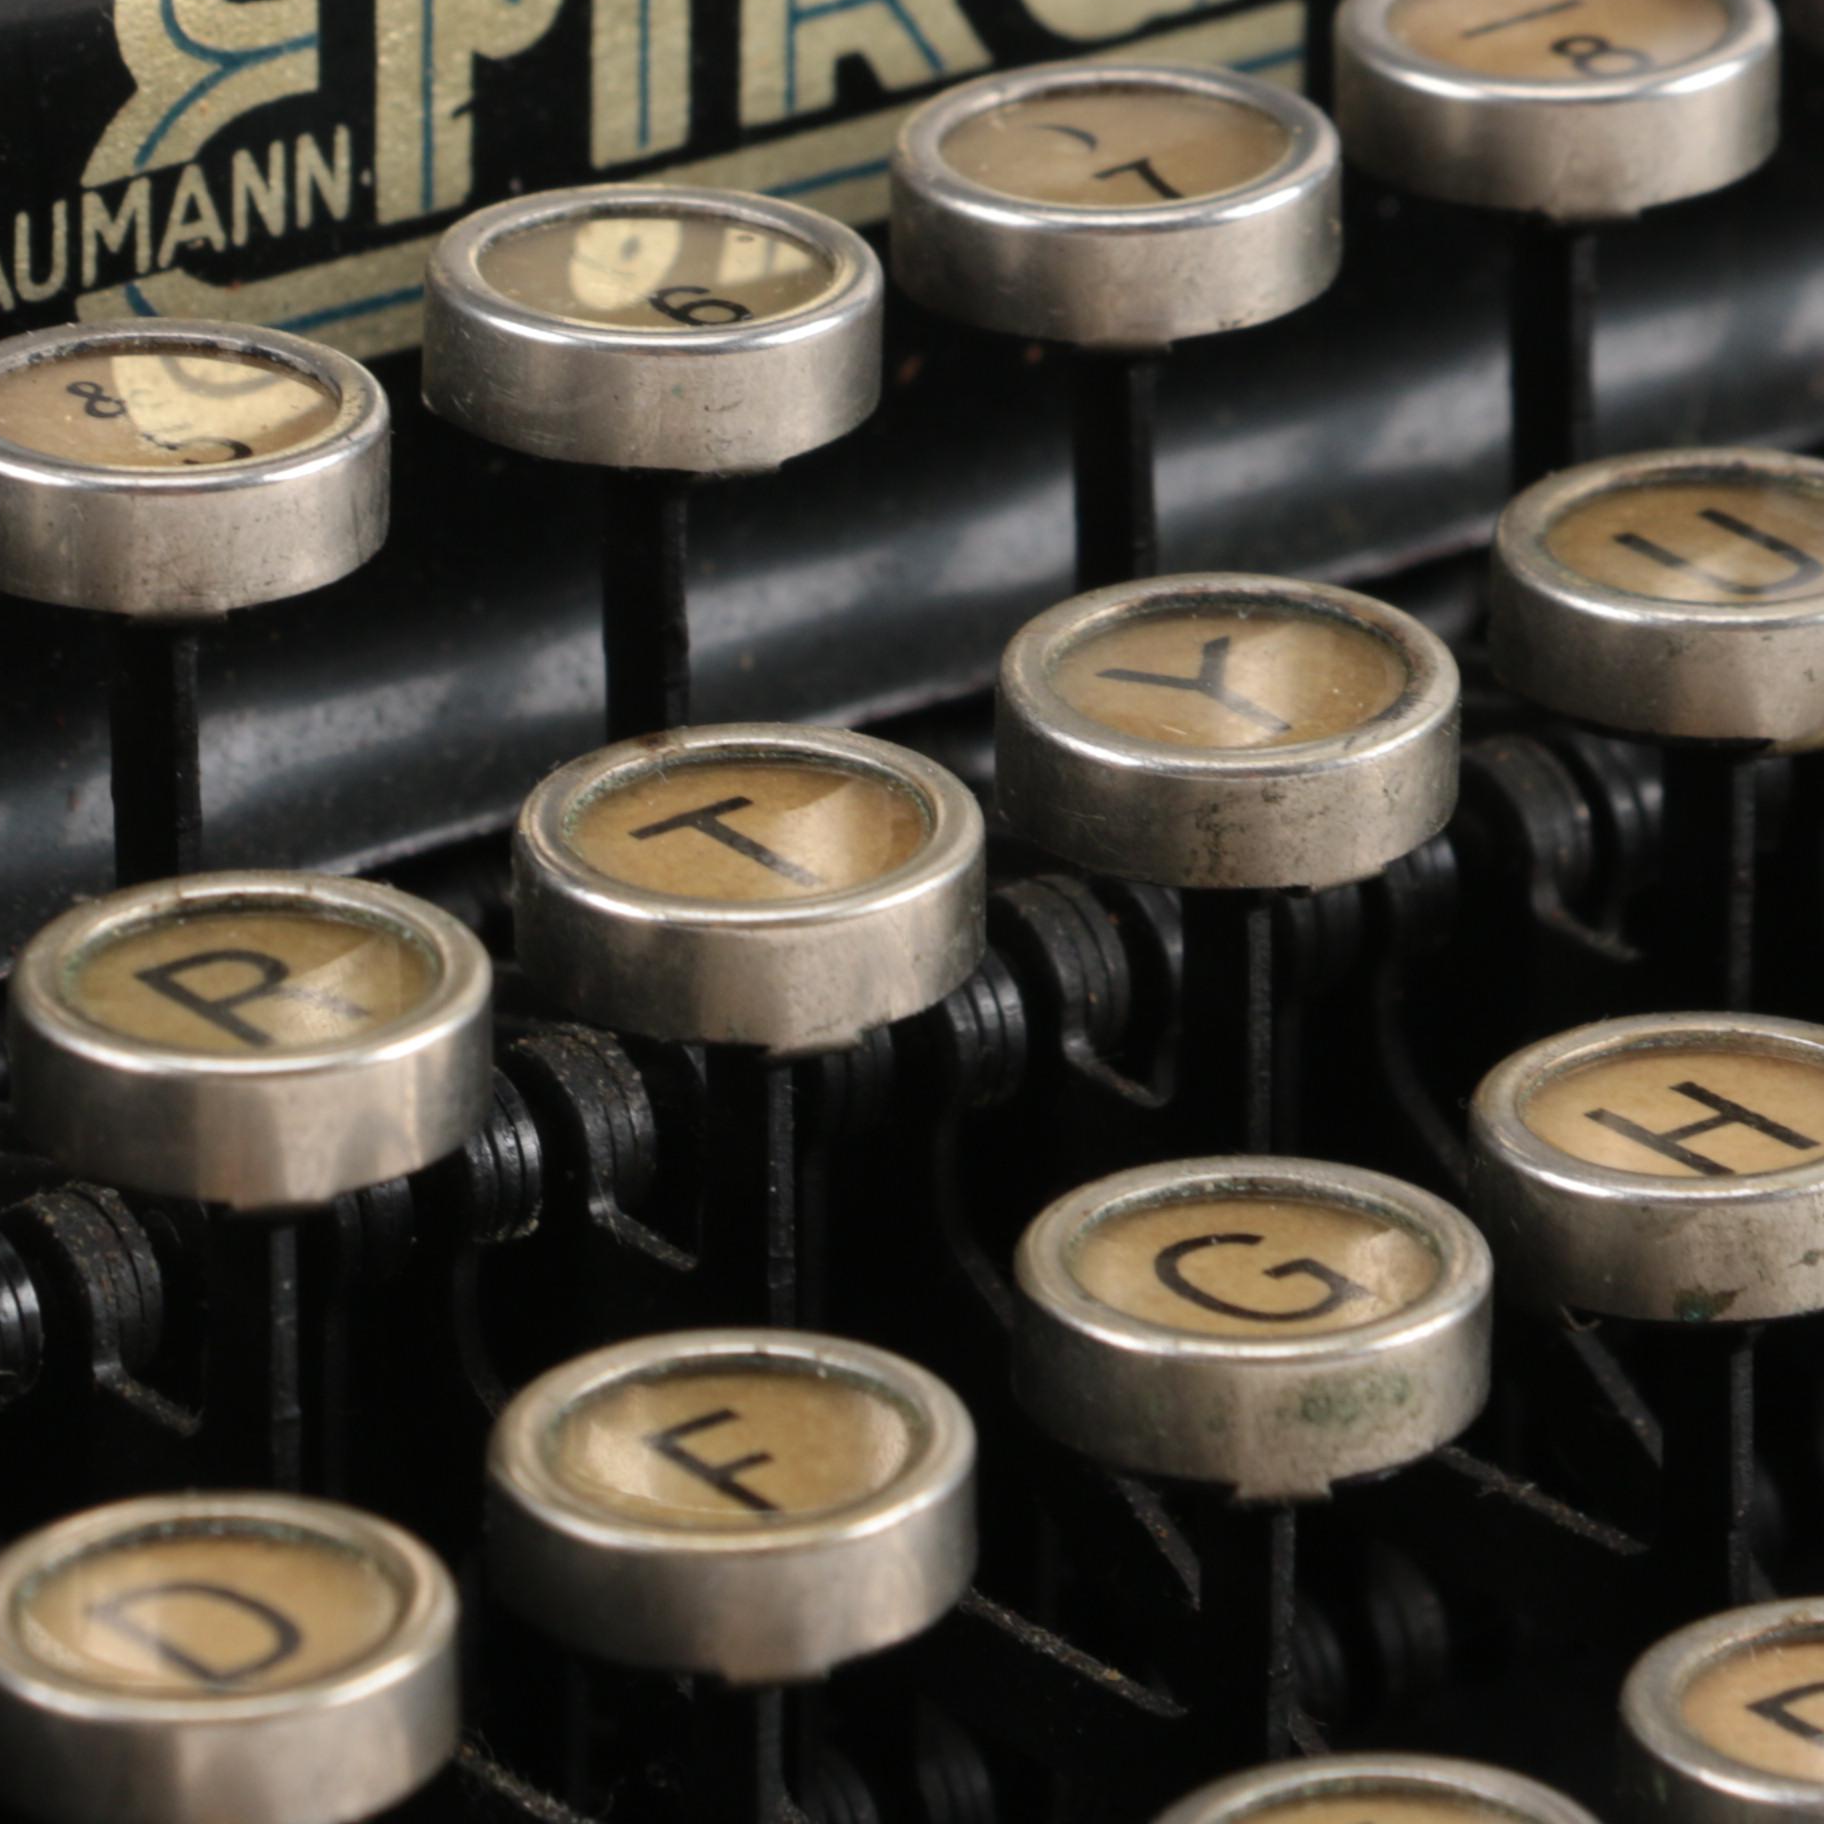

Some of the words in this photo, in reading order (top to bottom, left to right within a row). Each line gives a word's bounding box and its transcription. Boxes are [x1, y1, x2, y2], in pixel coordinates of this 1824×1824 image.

[1548, 34, 1654, 77] 8
[1092, 156, 1184, 200] 7
[648, 284, 754, 327] 6
[1611, 505, 1824, 596] U
[1094, 634, 1292, 733] Y
[628, 795, 821, 889] T
[1582, 1079, 1821, 1175] H
[1153, 1231, 1370, 1324] G
[641, 1407, 786, 1514] F
[86, 1581, 303, 1686] D
